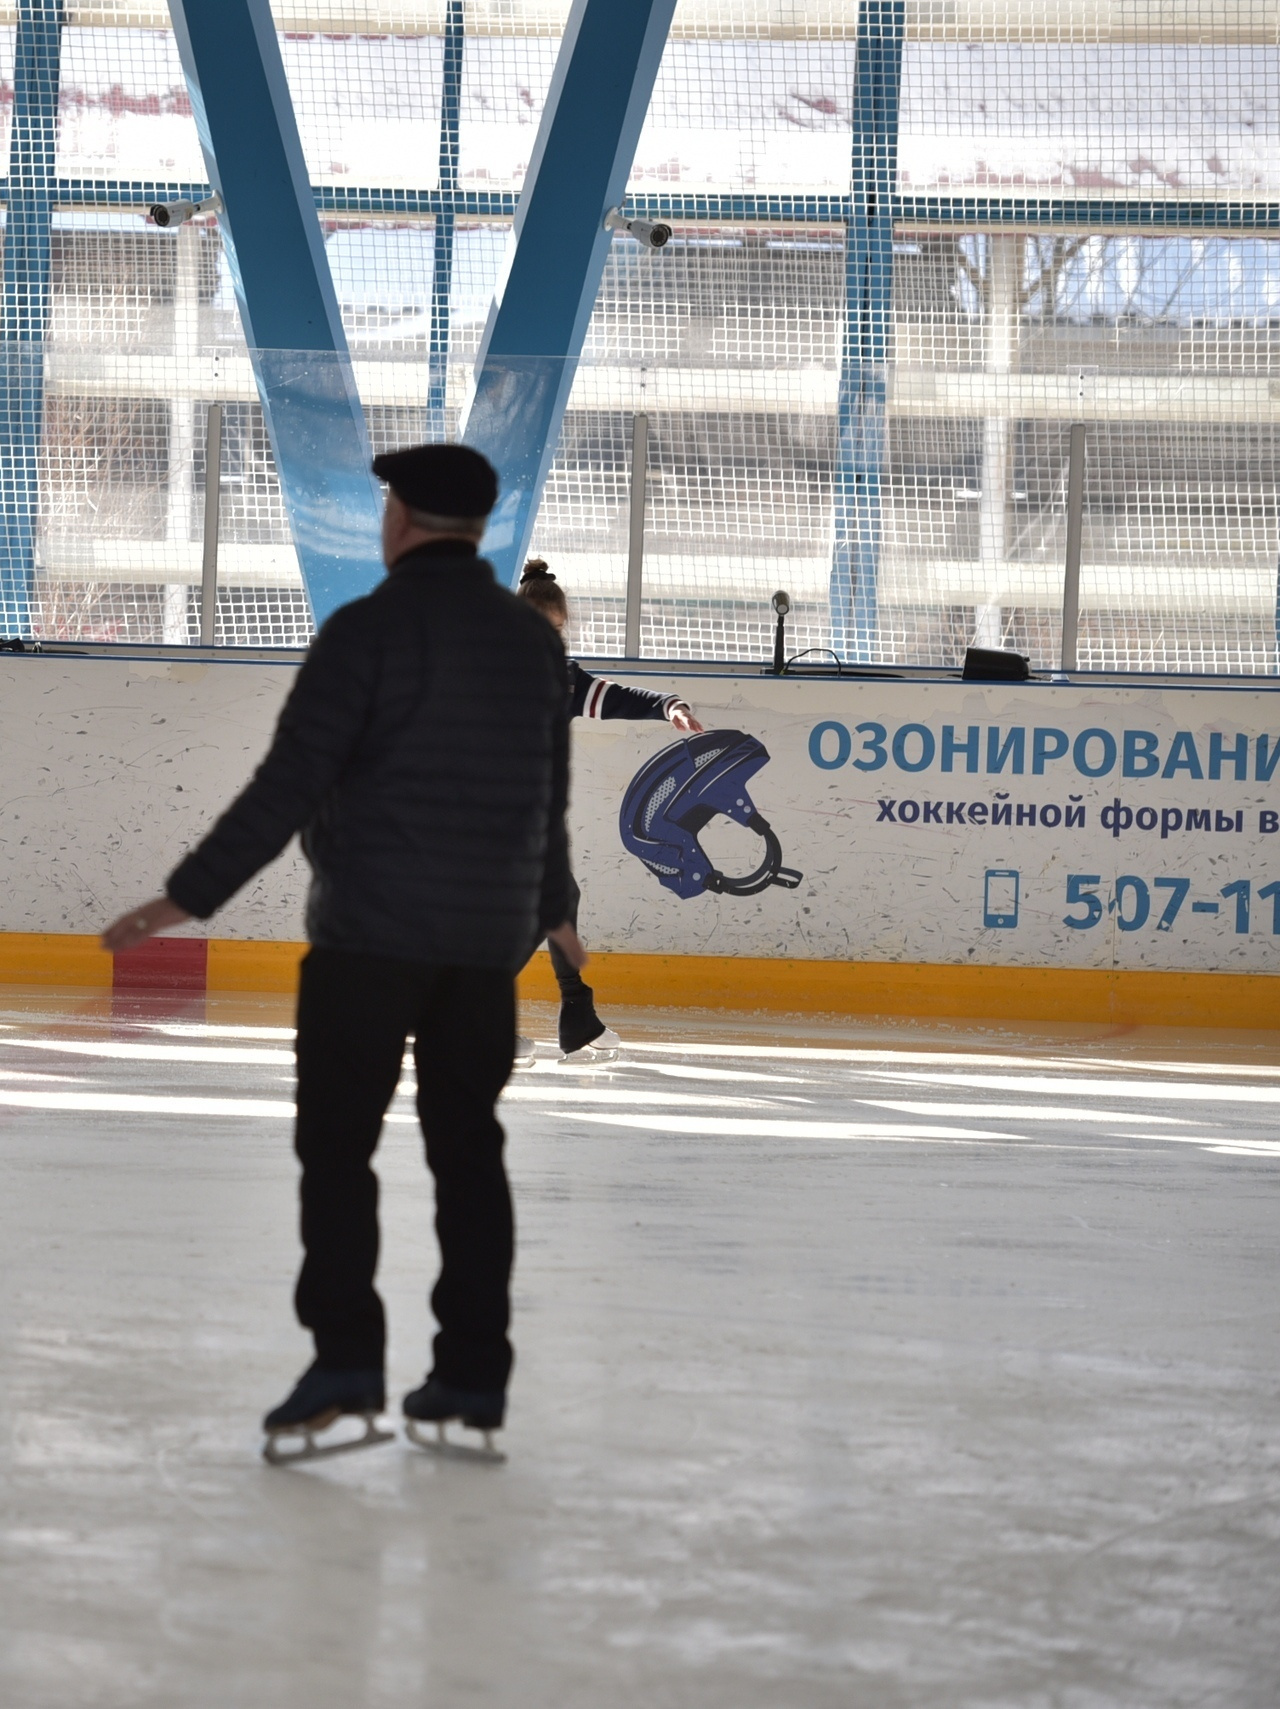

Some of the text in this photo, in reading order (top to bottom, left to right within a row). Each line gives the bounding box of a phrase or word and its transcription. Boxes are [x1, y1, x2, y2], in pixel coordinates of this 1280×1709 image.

[808, 720, 1280, 783] ОЗОНИРОВАНИ
[876, 792, 1280, 839] хоккейной формы в
